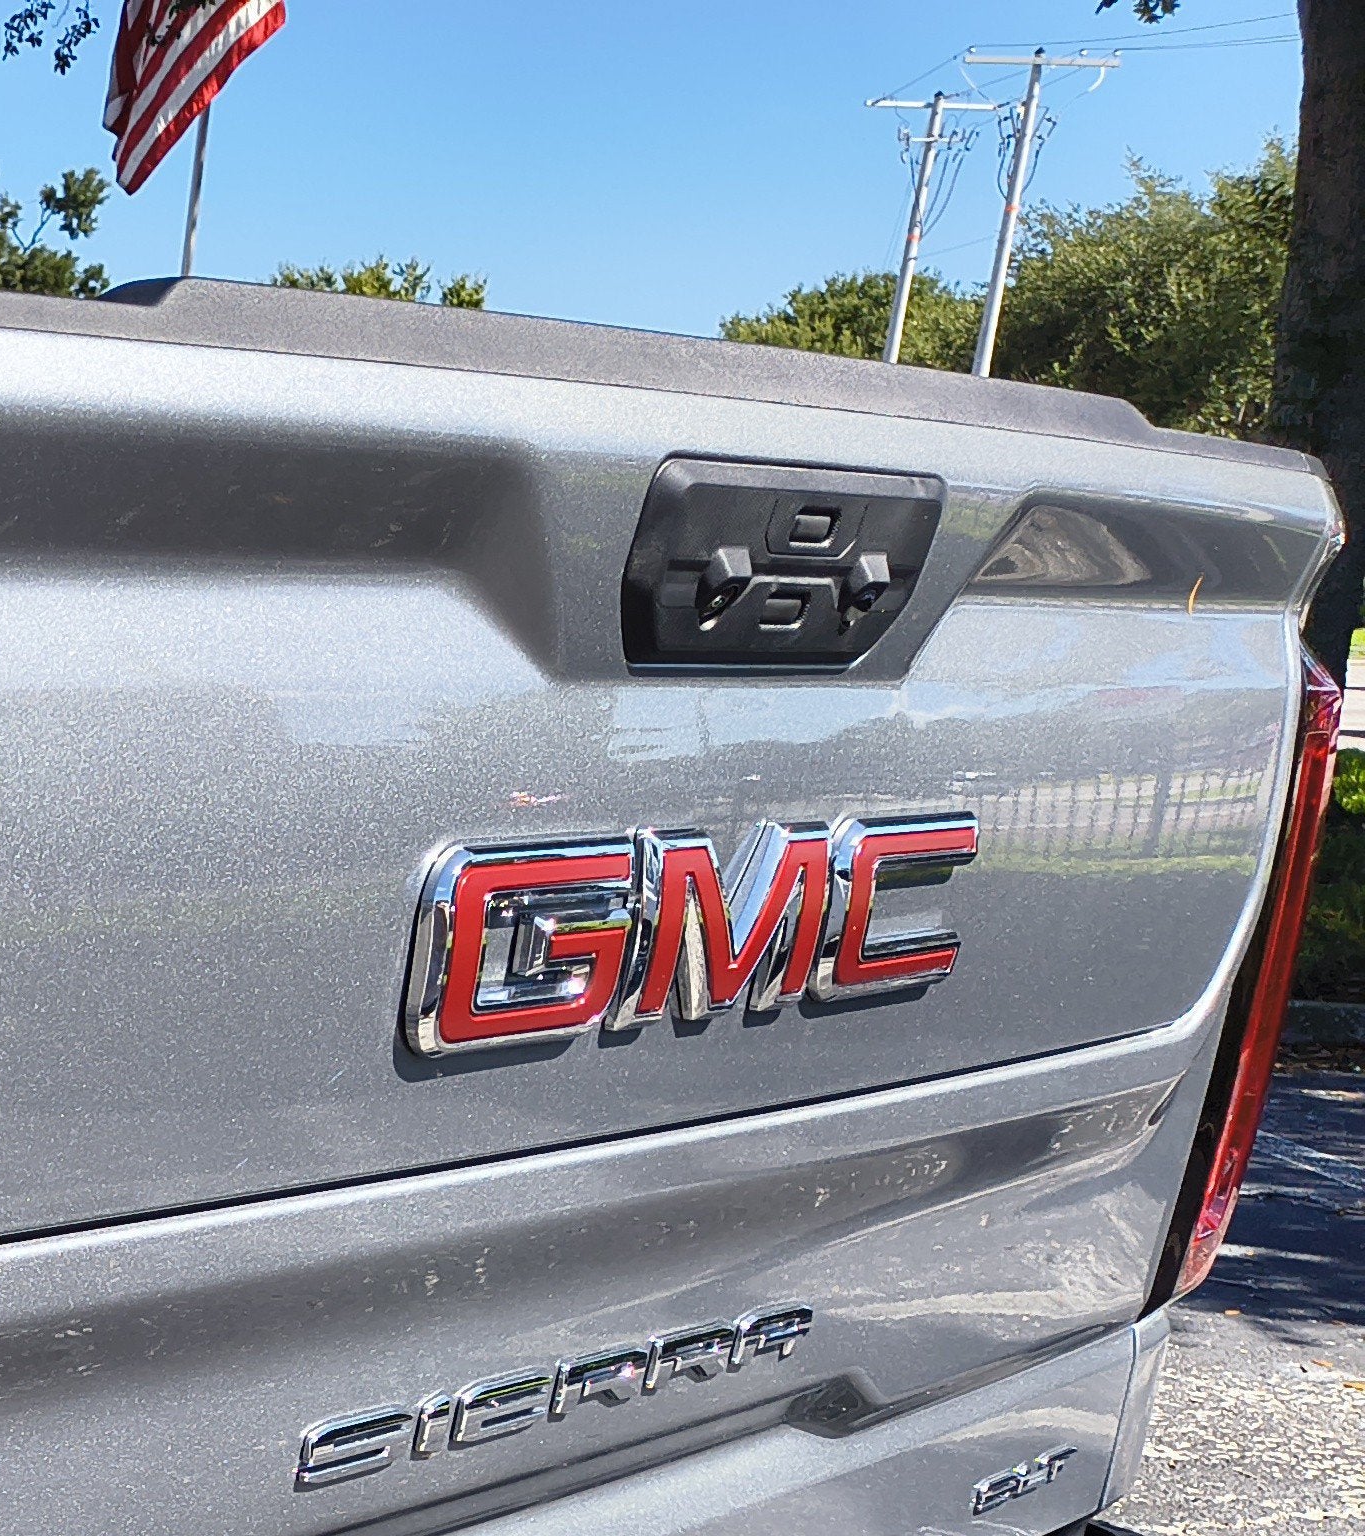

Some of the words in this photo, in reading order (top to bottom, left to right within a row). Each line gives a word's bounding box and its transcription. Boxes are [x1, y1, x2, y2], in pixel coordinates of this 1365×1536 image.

[402, 810, 979, 1060] GMC
[293, 1302, 814, 1484] SIERRA
[971, 1443, 1078, 1514] SLT
